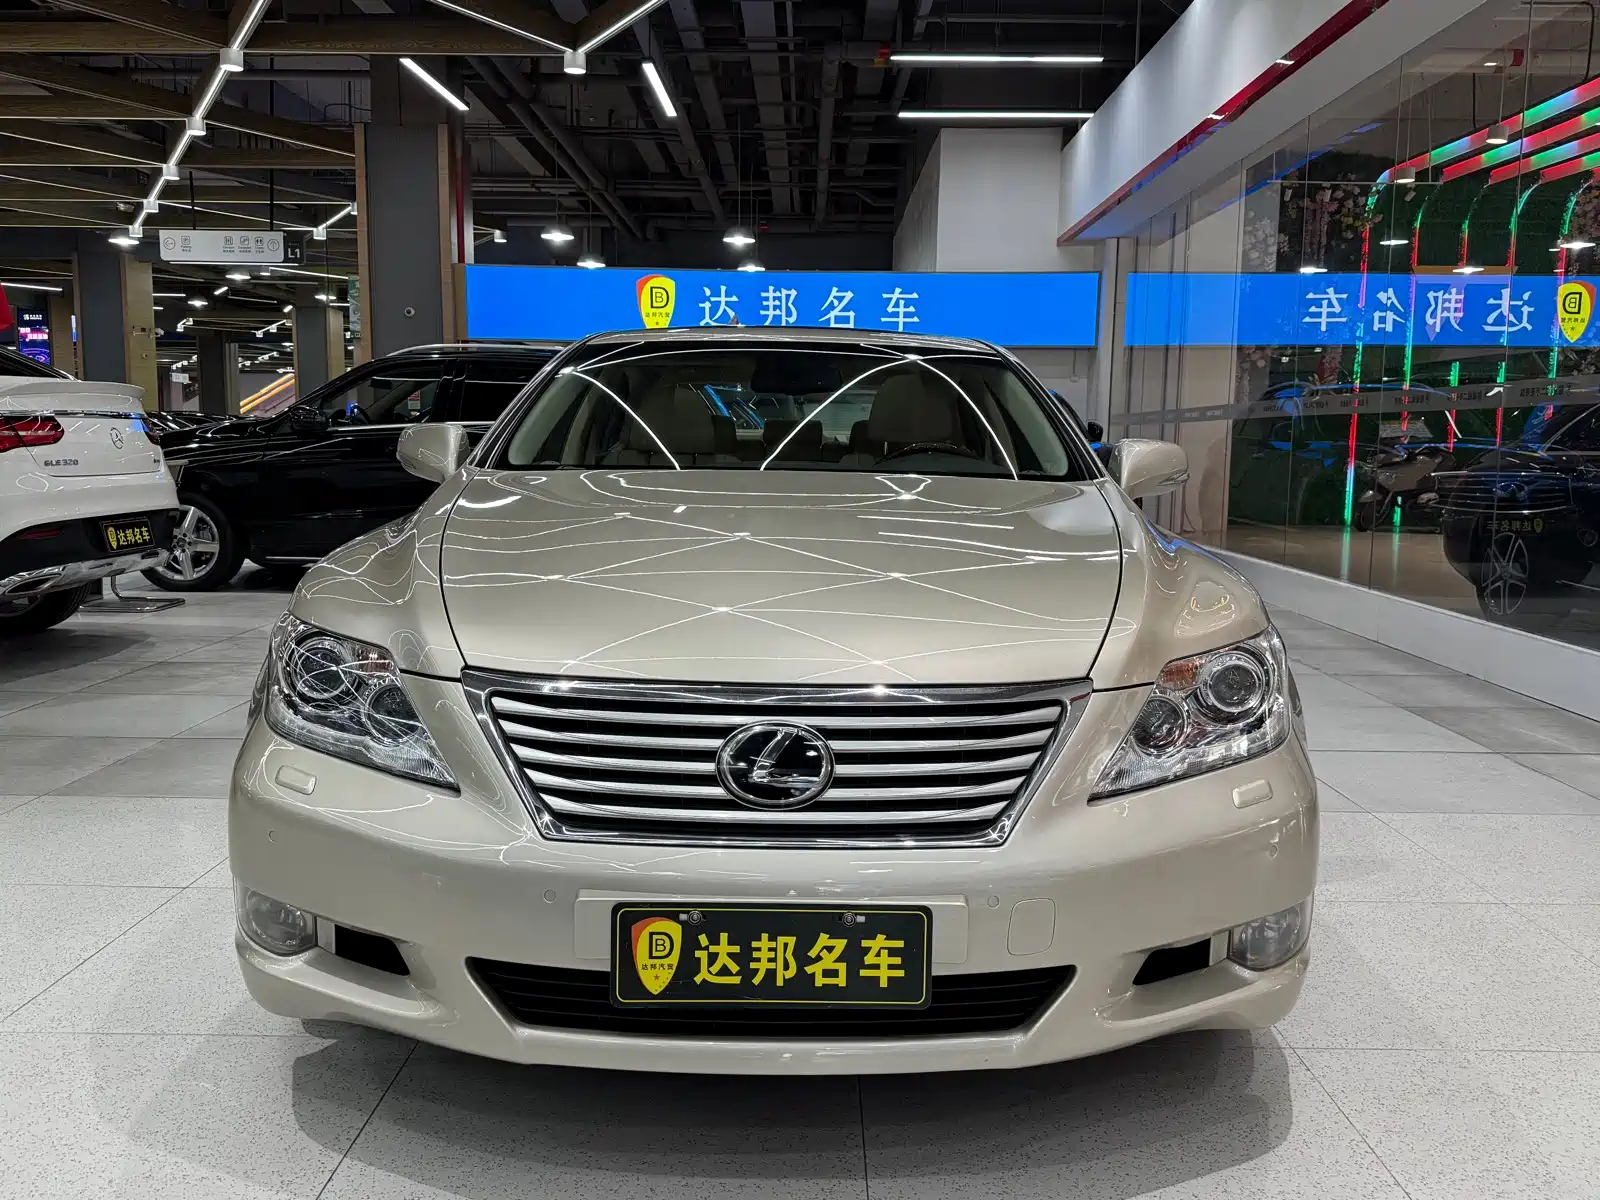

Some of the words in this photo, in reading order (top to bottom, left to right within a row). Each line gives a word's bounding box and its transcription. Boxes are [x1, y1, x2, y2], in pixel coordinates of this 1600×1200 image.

[288, 247, 300, 258] L1
[698, 285, 920, 331] 达邦名车
[116, 526, 150, 545] 达邦名车
[692, 932, 906, 988] 达邦名车
